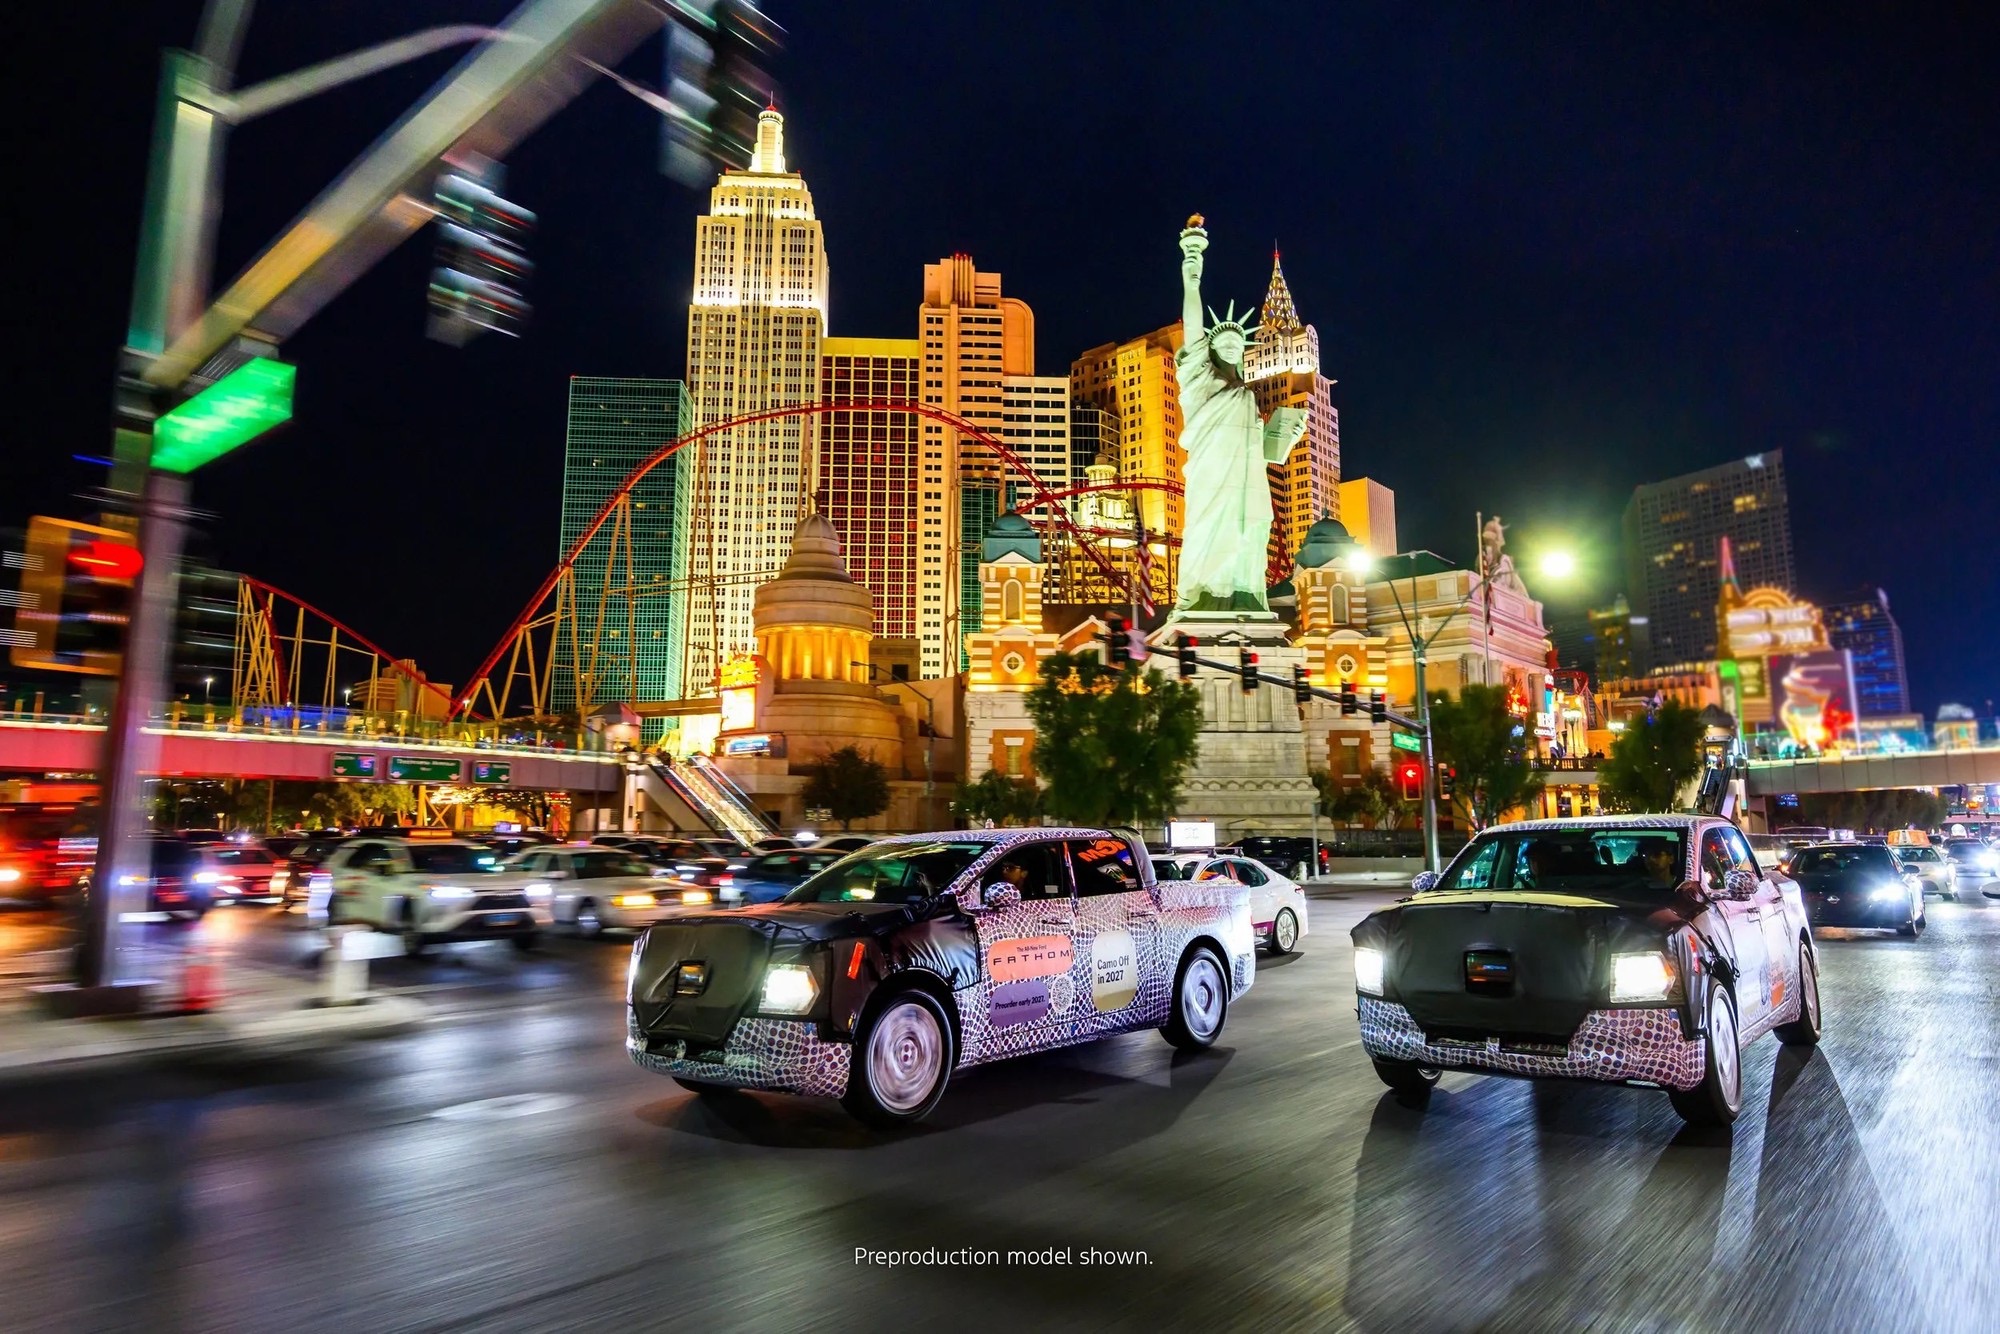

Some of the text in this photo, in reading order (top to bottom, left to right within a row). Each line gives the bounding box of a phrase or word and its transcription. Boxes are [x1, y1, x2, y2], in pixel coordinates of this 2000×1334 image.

[993, 949, 1070, 966] FATHOM
[1097, 955, 1130, 970] Camo Off
[1097, 970, 1124, 985] in 2027
[994, 1000, 1018, 1010] Preorder
[1018, 998, 1031, 1006] early
